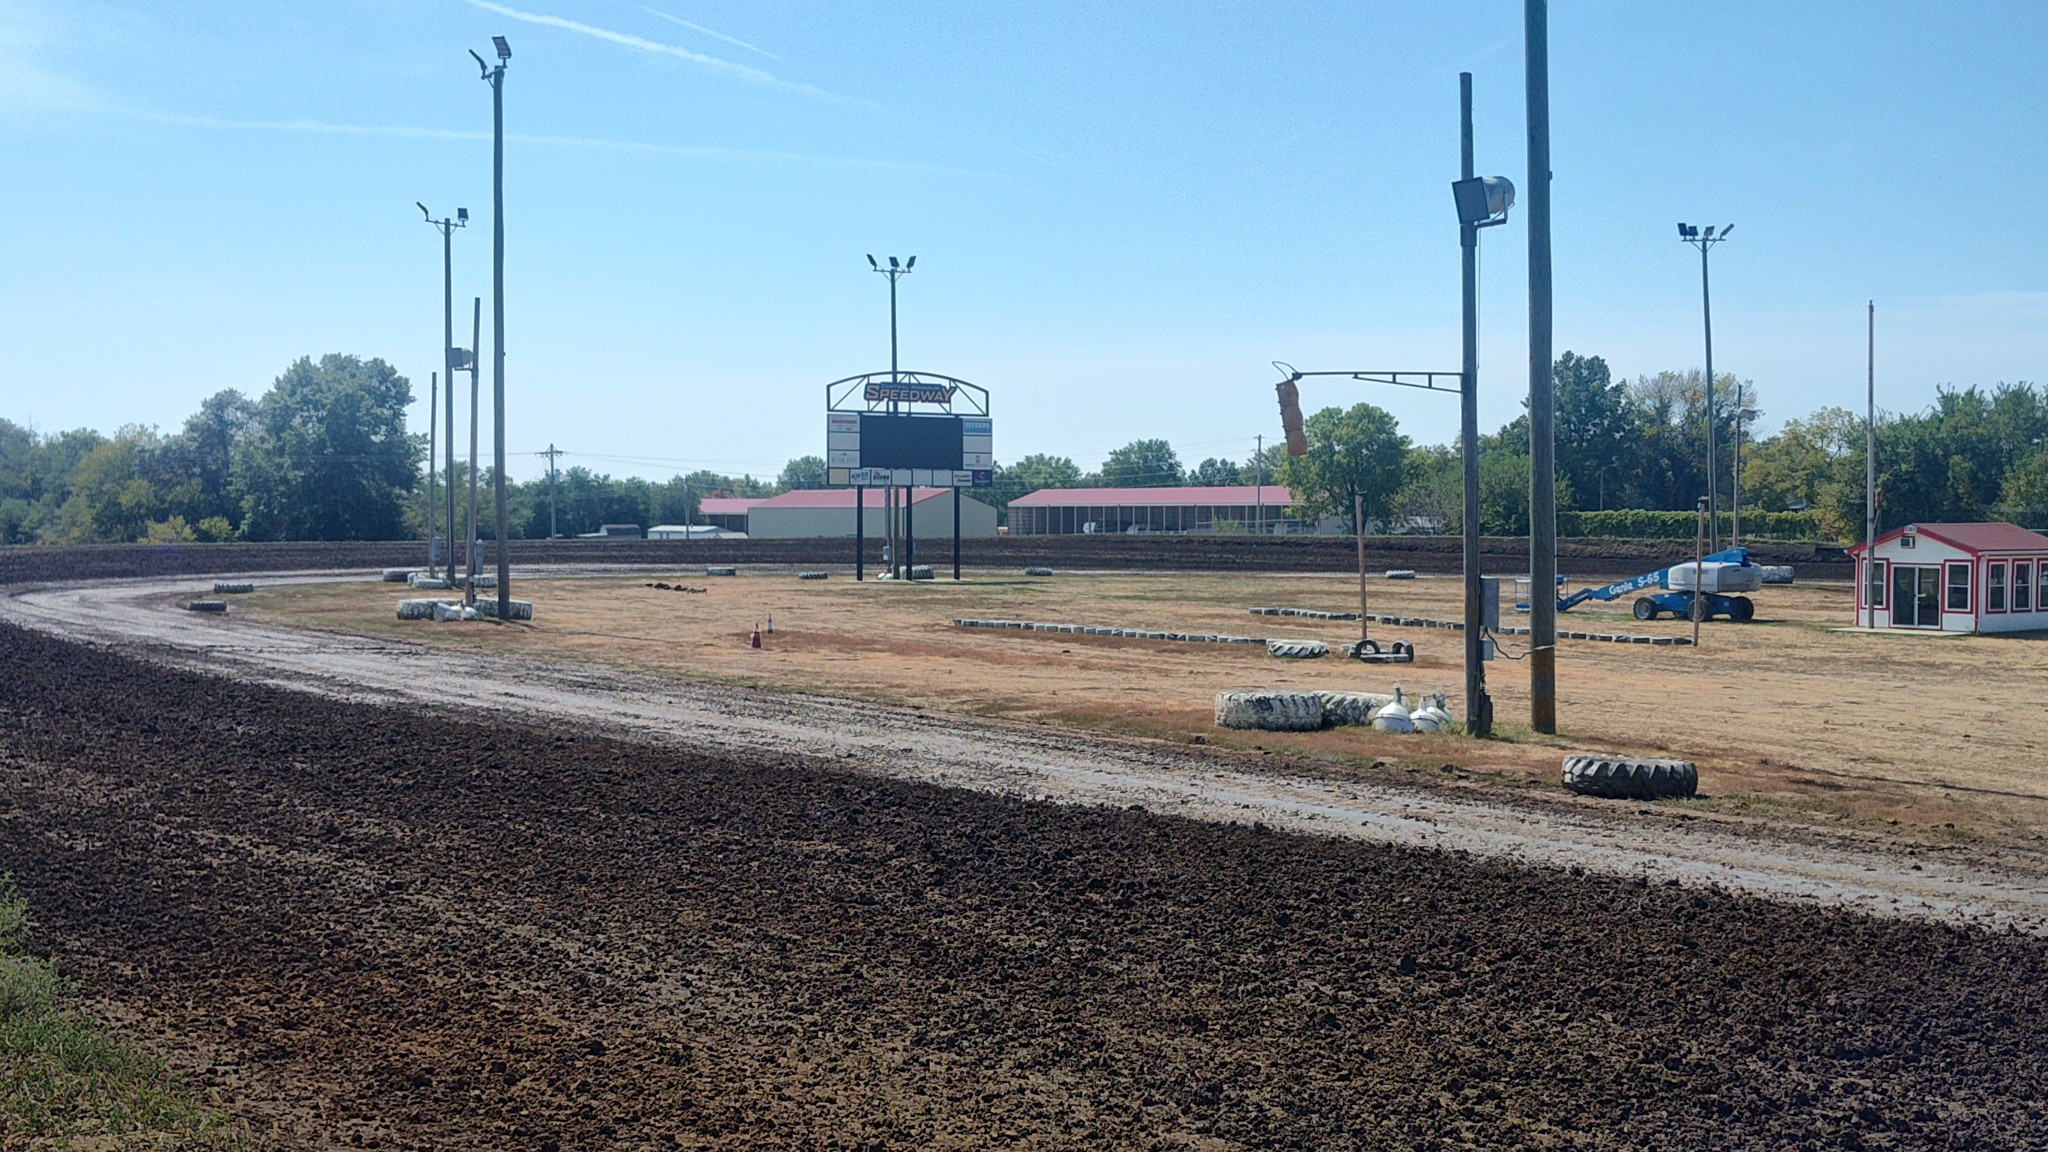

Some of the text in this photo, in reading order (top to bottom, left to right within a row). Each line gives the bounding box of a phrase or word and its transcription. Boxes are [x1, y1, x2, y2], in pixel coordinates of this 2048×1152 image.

[865, 384, 956, 402] SPEEDWAY
[1608, 571, 1660, 595] Genie S-65
